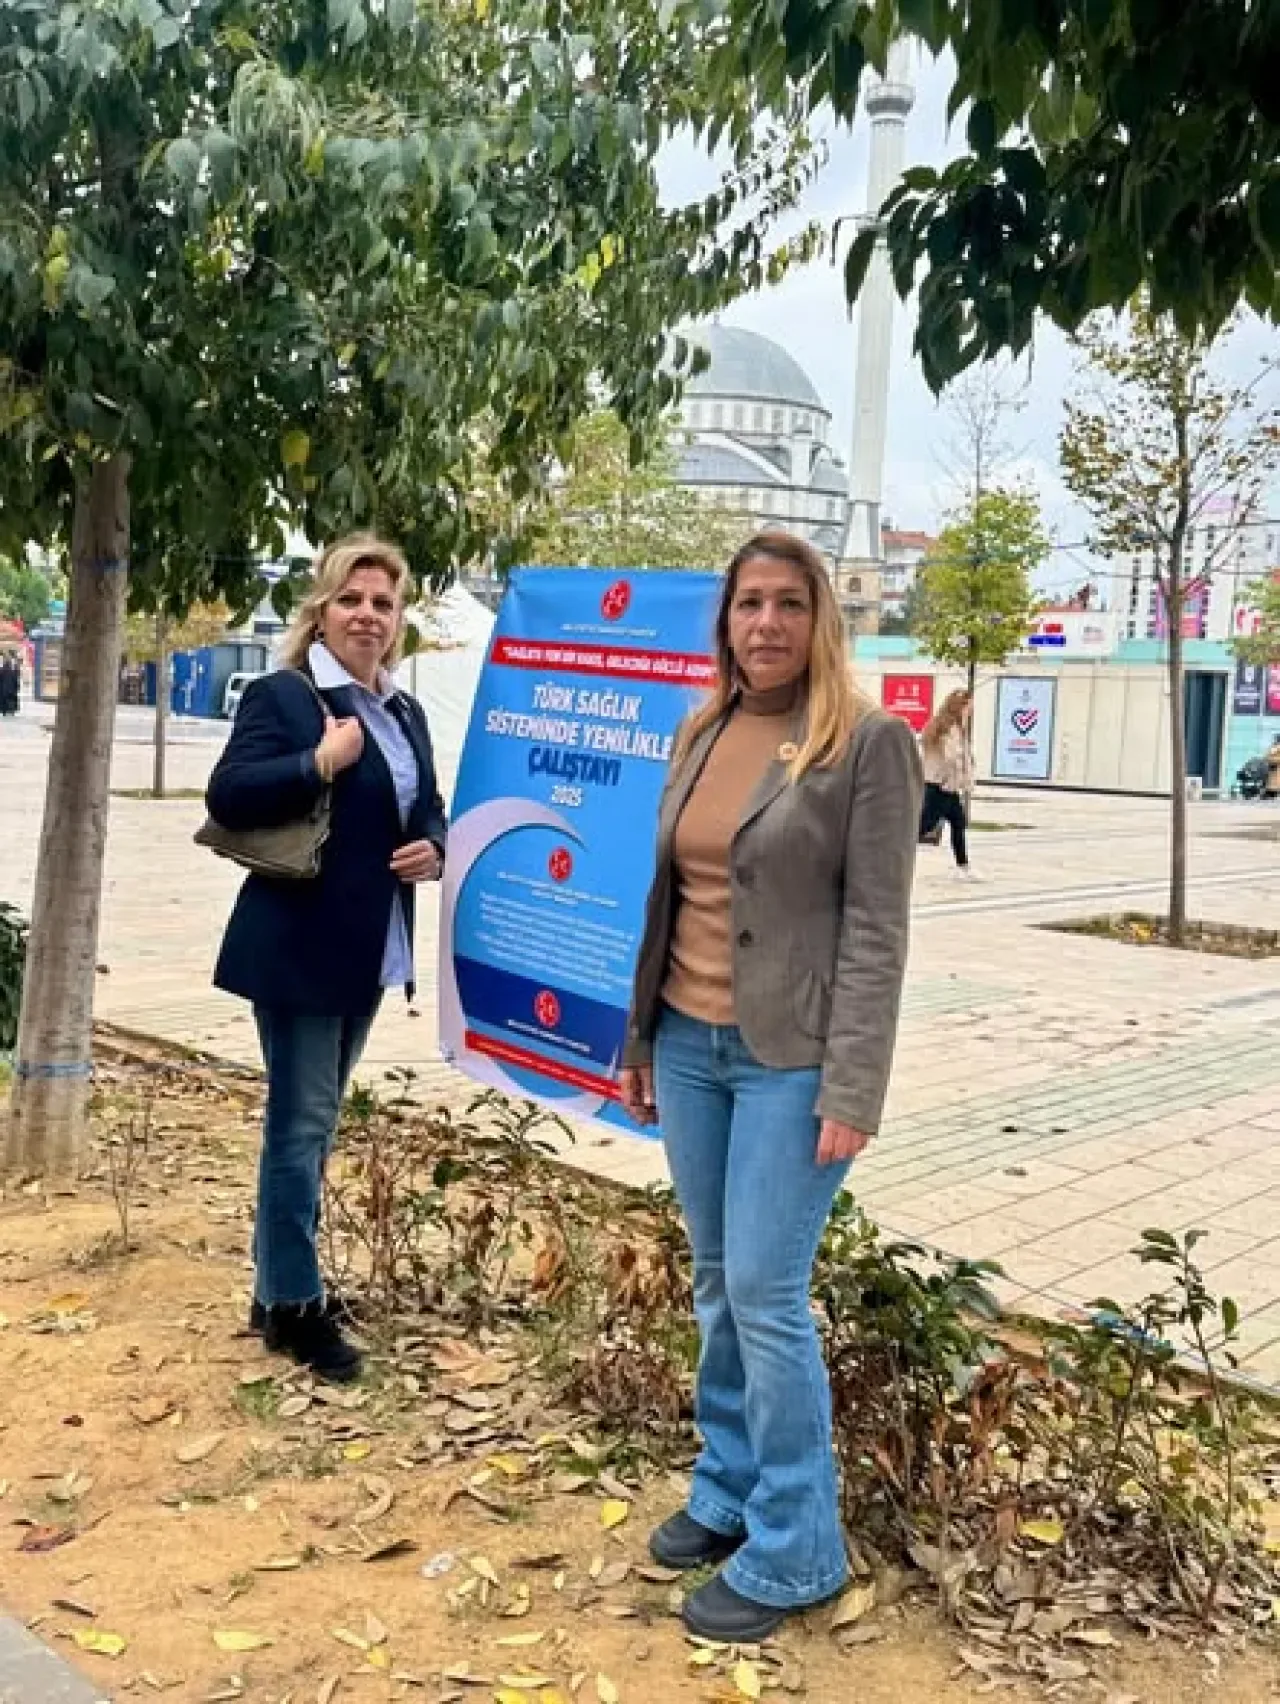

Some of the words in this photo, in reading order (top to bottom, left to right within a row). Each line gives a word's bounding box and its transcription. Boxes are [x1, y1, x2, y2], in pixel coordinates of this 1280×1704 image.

[533, 681, 574, 712] TÜRK
[576, 687, 642, 722] SAĞLIK
[485, 704, 579, 745] SİSTEMİNDE
[529, 747, 622, 786] ÇALIŞTAYI
